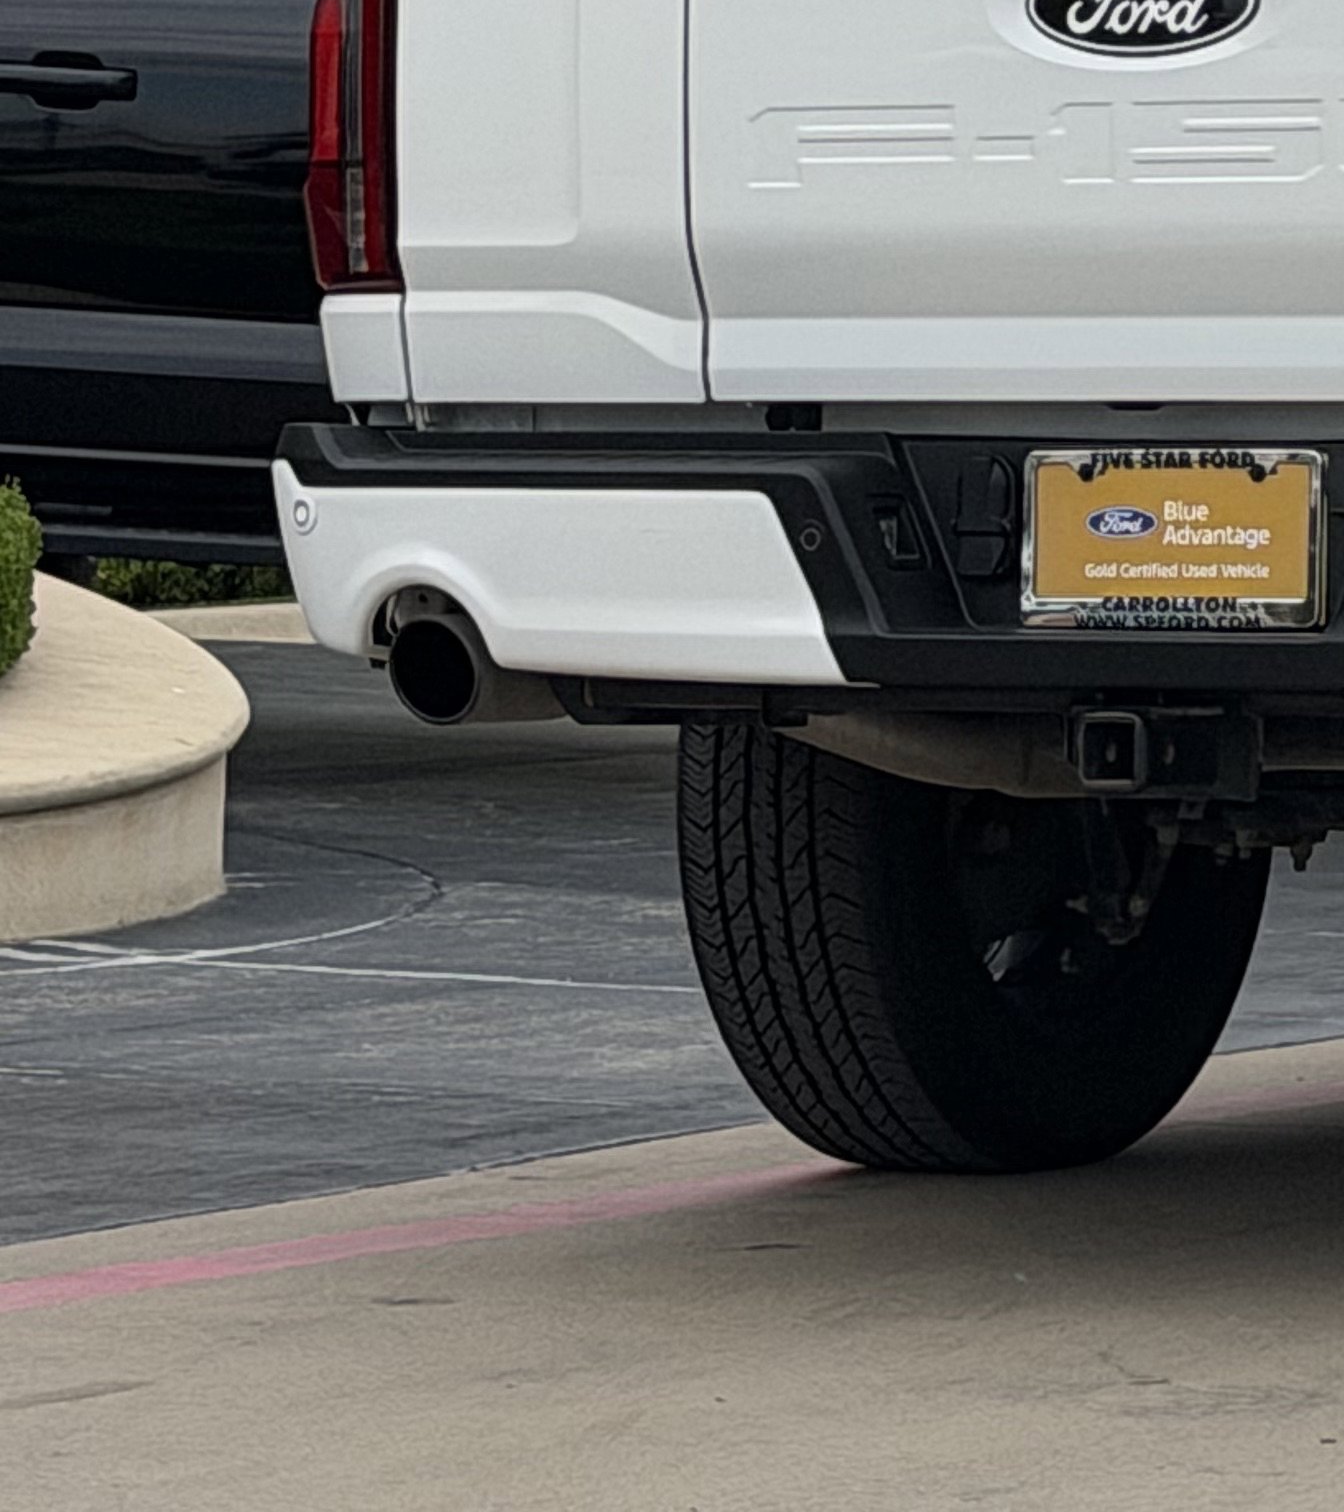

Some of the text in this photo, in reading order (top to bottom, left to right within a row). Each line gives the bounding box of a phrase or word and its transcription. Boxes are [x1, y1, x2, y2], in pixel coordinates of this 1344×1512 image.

[1091, 450, 1255, 469] FIVE STAR FORD
[1163, 500, 1209, 522] Blue
[1162, 524, 1271, 549] Advantage
[1084, 563, 1270, 579] Gold Certified Used Vehicle
[1101, 596, 1238, 612] CARROLLTON
